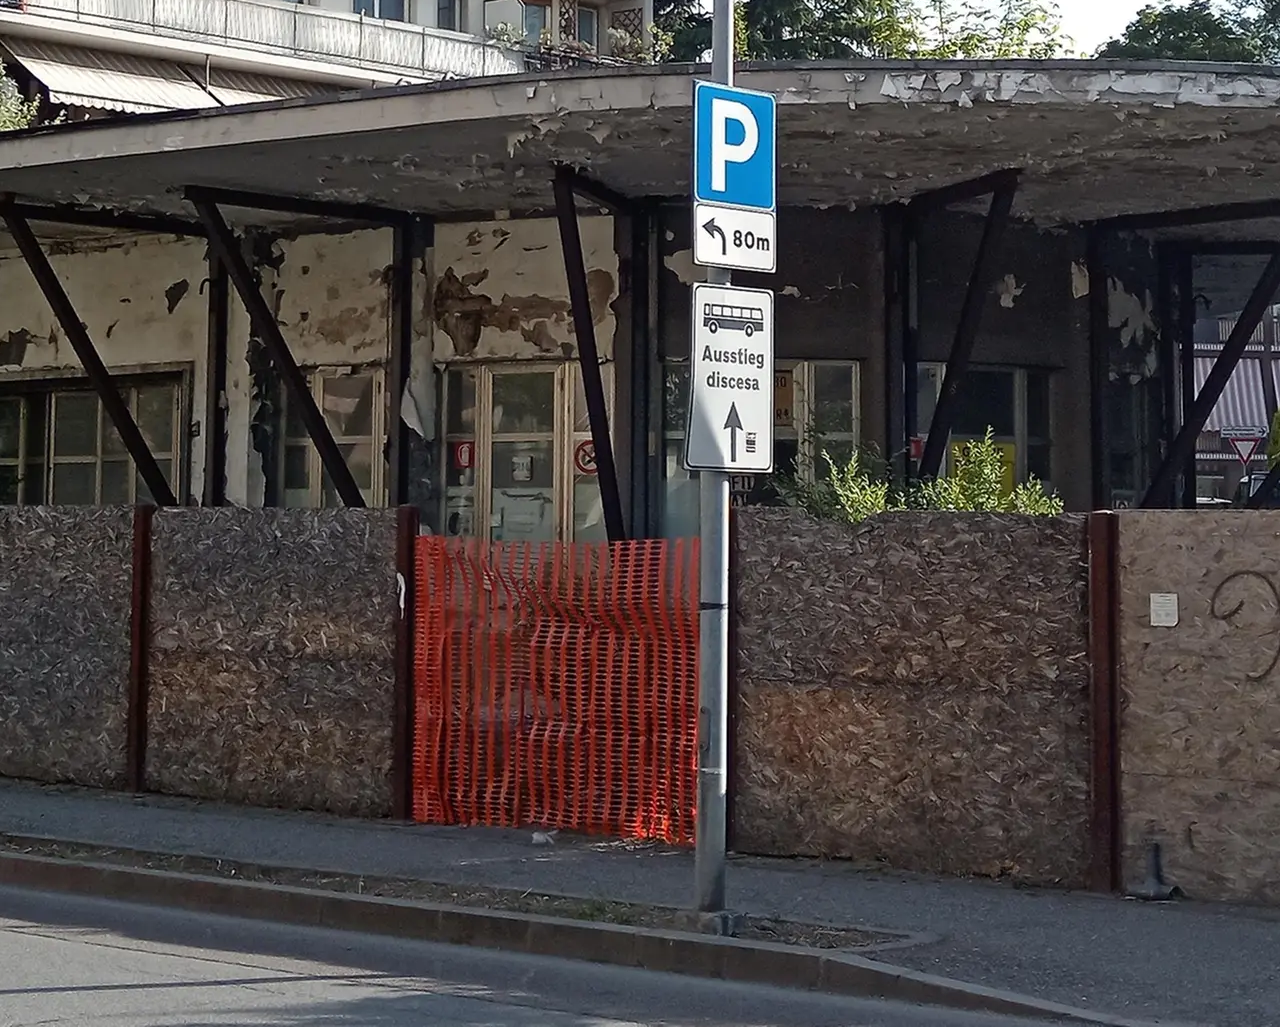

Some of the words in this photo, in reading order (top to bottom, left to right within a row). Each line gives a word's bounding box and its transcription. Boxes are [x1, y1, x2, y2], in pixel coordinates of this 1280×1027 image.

[711, 97, 759, 192] P
[733, 229, 770, 251] 80m
[702, 344, 765, 369] Ausstieg
[706, 371, 760, 391] discesa
